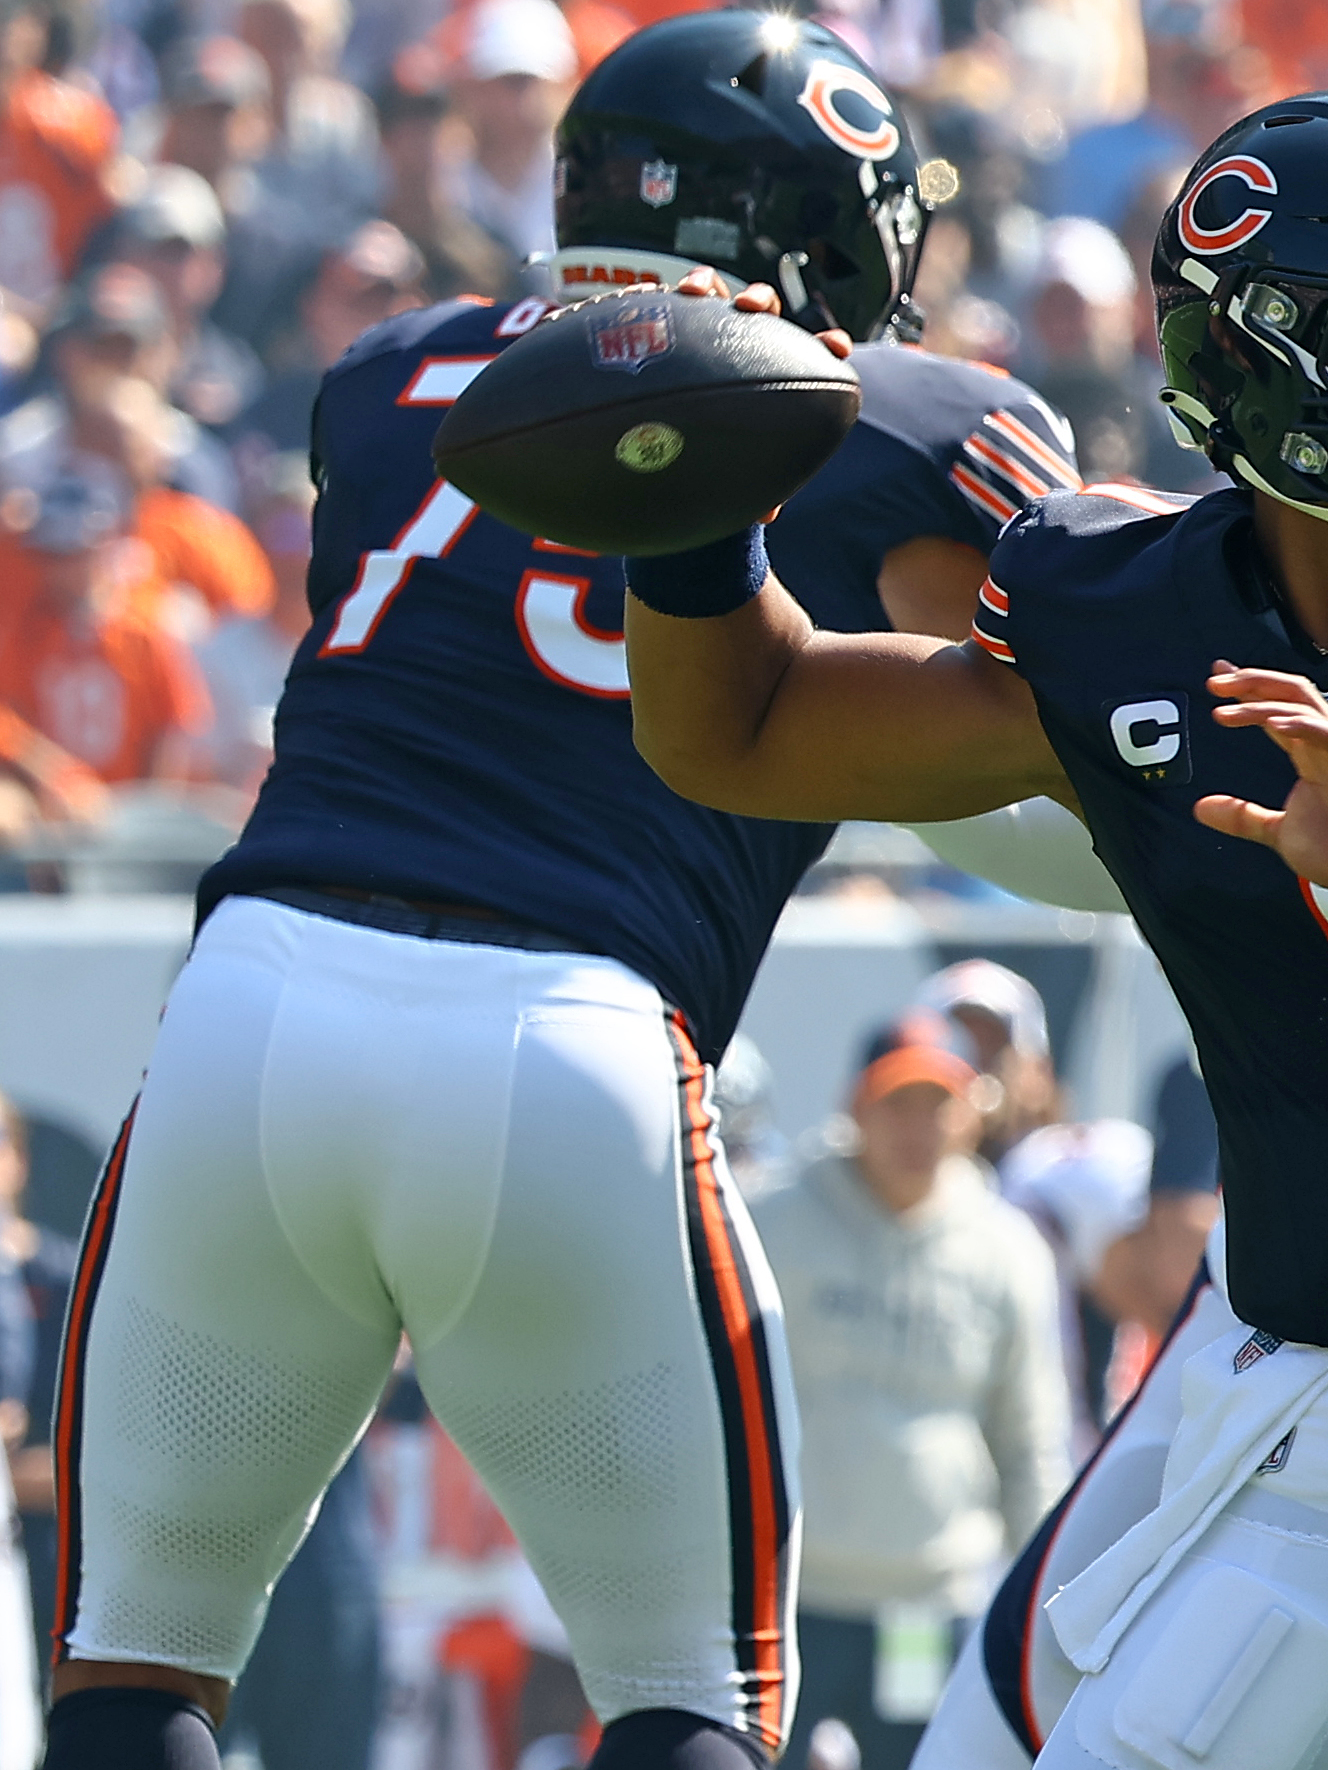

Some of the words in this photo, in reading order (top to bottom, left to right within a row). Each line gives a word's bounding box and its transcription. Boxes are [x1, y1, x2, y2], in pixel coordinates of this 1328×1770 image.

[1178, 154, 1278, 255] C
[599, 319, 670, 360] NFL
[316, 352, 634, 701] 7
[1109, 699, 1181, 767] C
